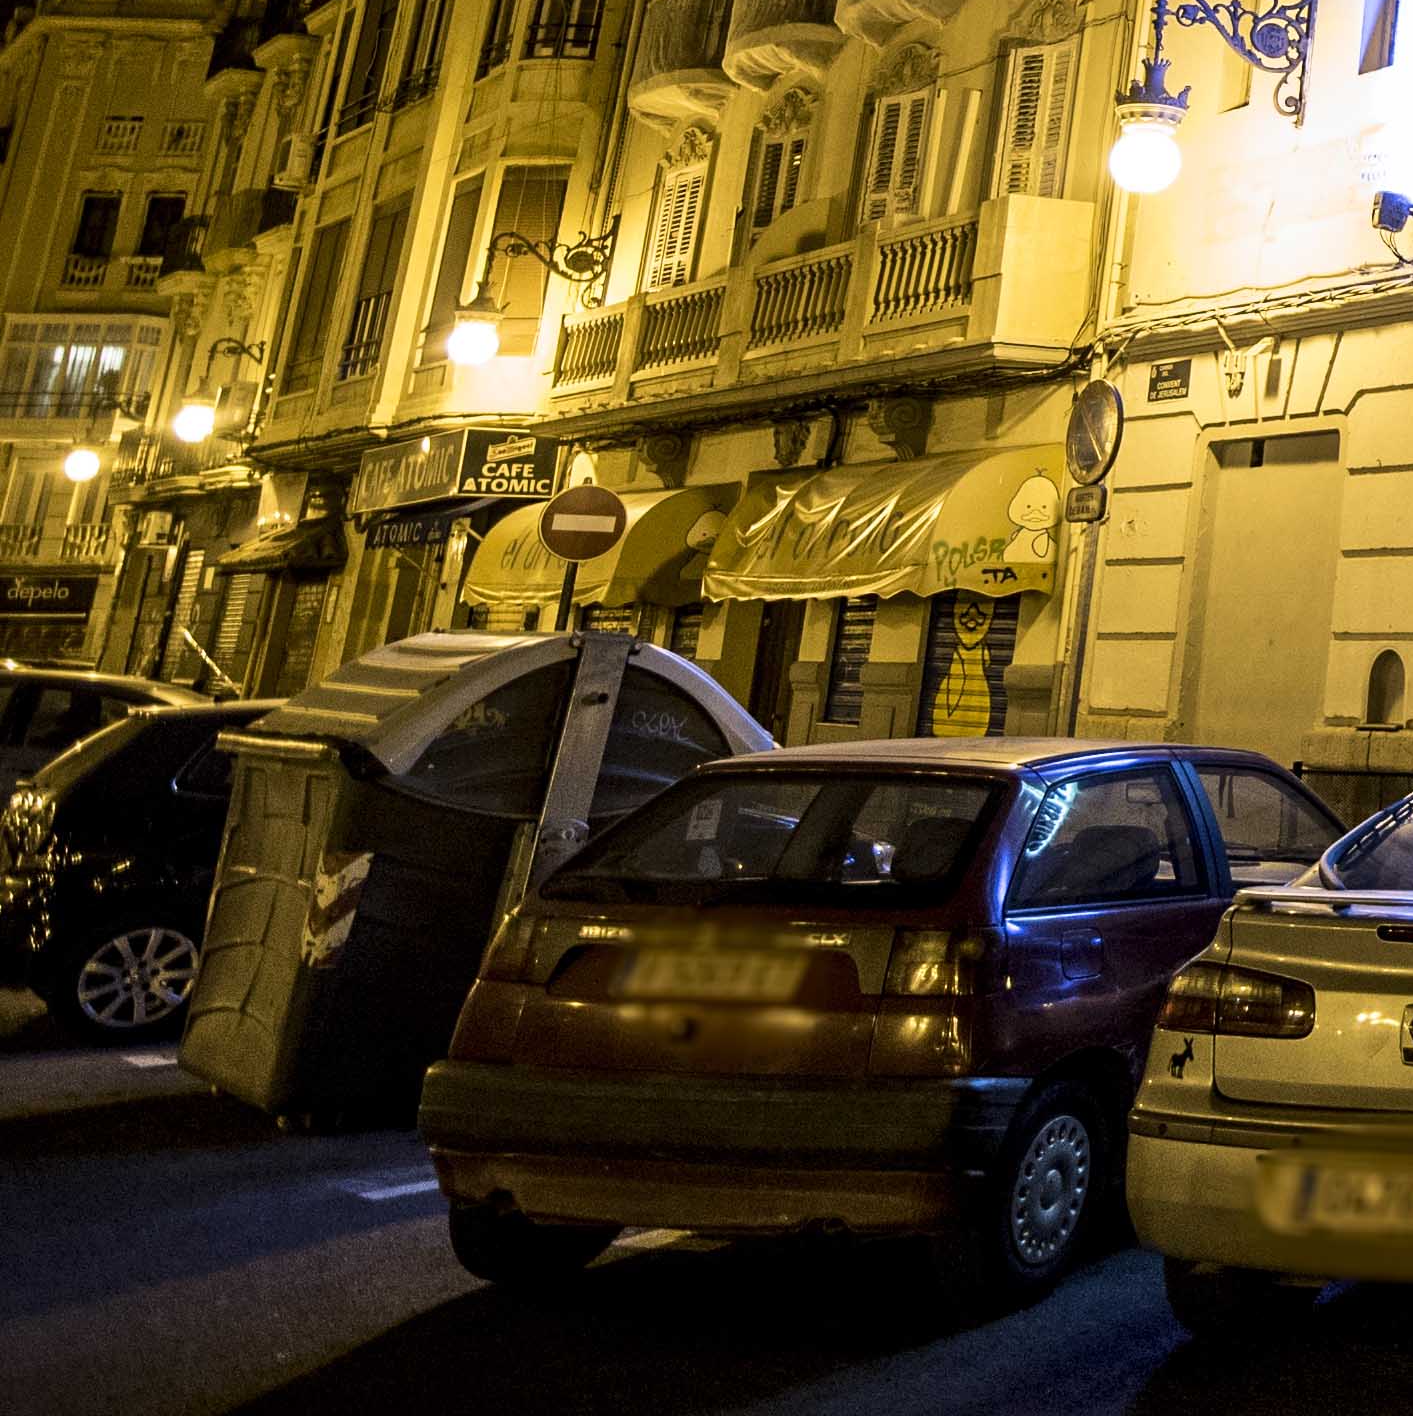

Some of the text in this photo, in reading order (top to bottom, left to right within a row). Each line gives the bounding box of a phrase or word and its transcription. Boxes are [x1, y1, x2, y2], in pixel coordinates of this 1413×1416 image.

[1157, 387, 1187, 399] JERUSALEM
[481, 462, 535, 478] CAFE
[462, 477, 550, 493] ATOMIC
[373, 521, 422, 546] ATOMIC
